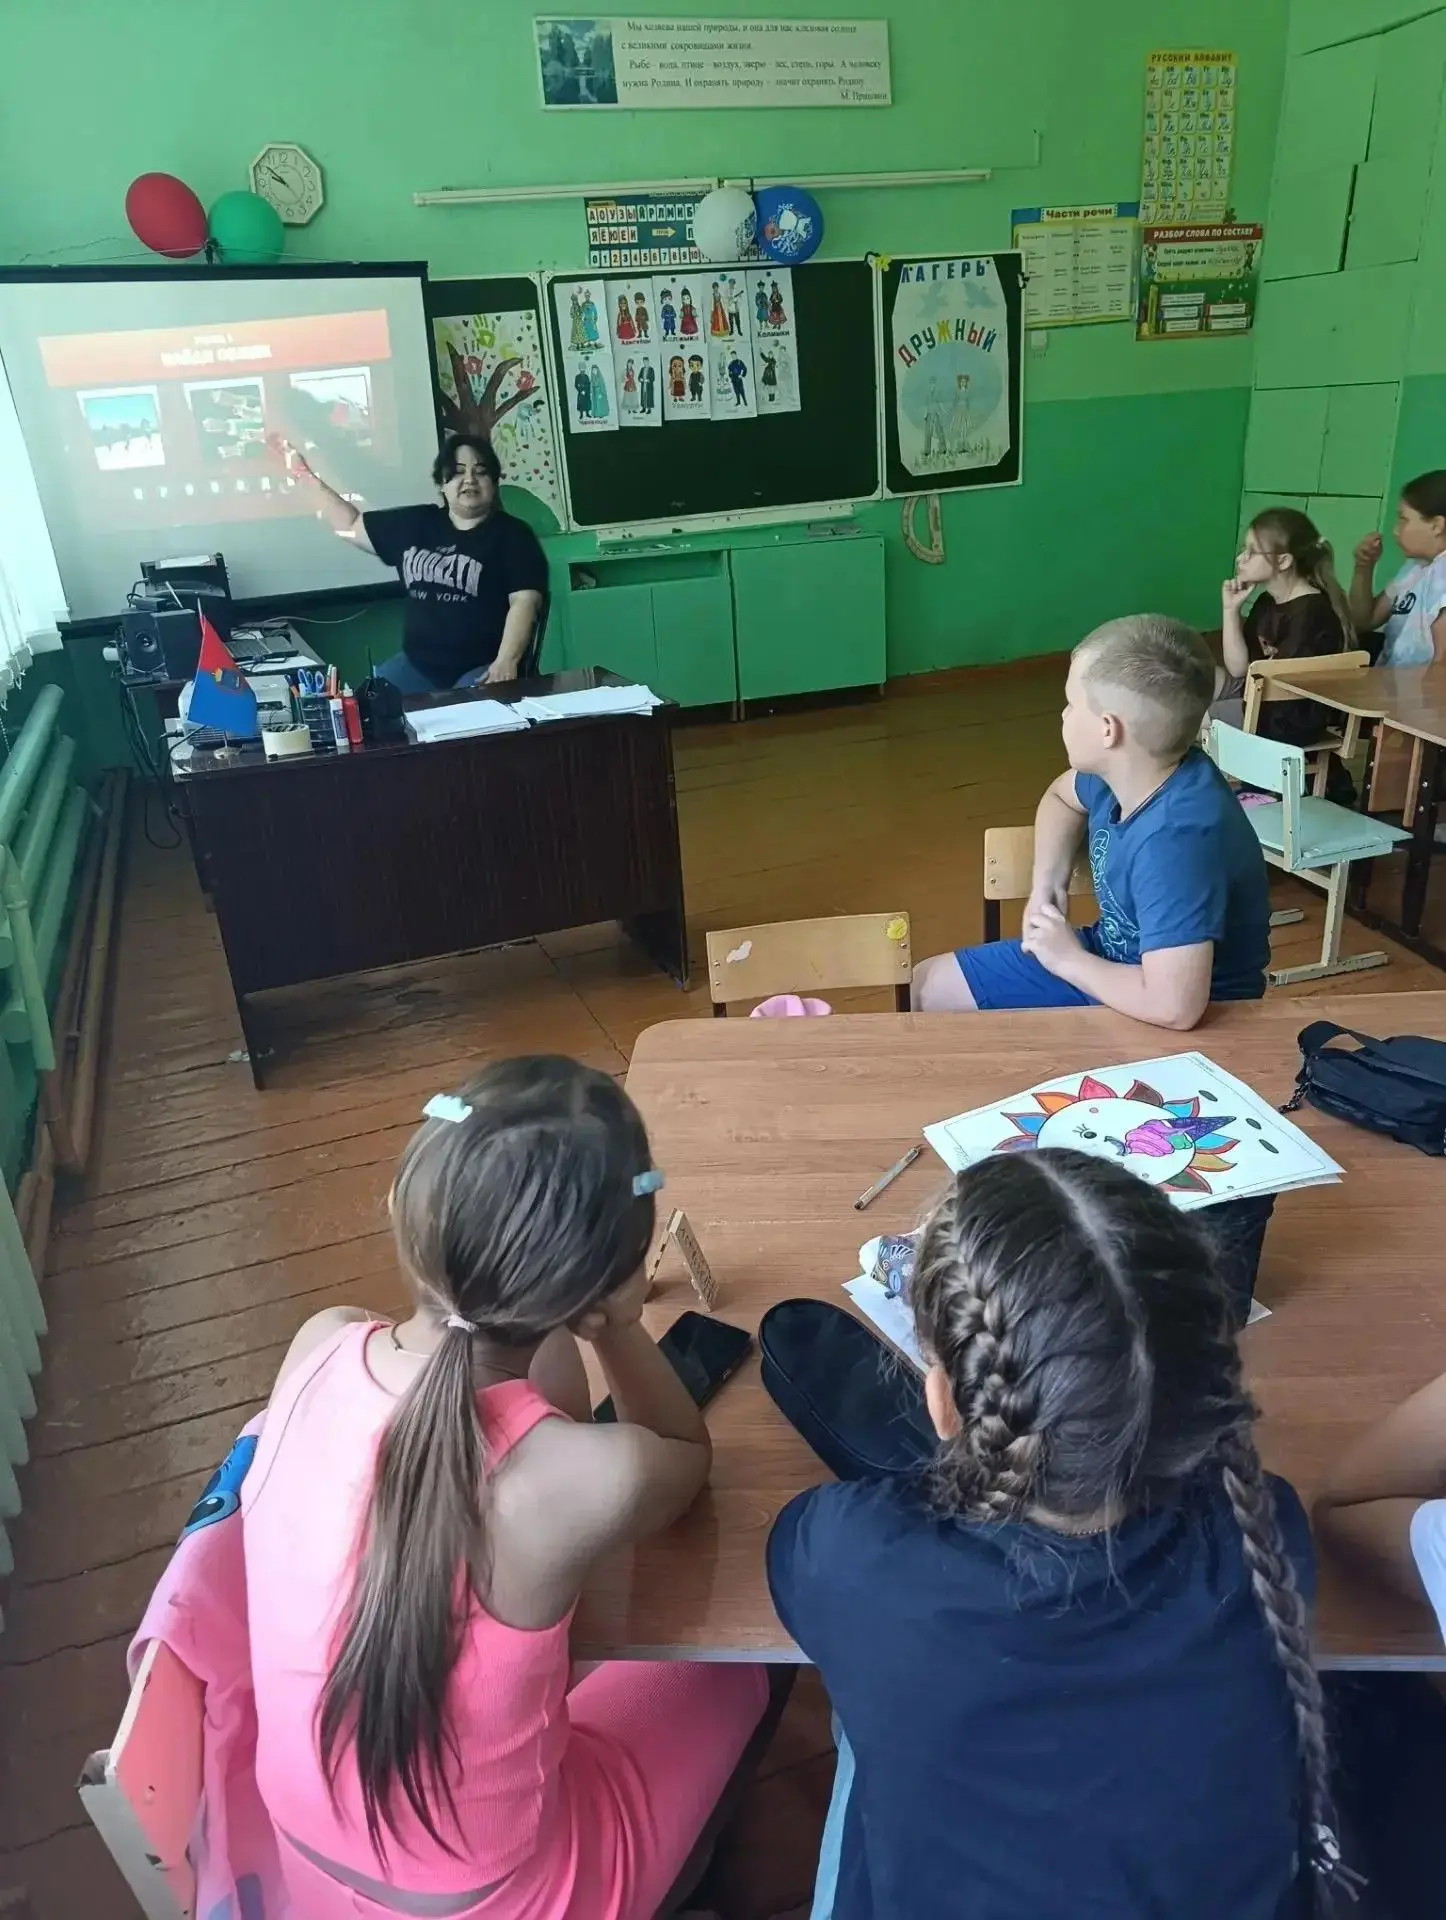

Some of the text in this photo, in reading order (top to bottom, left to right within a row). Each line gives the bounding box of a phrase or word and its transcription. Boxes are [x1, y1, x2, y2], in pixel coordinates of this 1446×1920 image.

[303, 166, 312, 178] 2
[1046, 208, 1113, 219] Части речи
[1154, 228, 1254, 240] РАЗБОР СЛОВА ПО СОСТАВУ
[692, 250, 698, 260] 10
[901, 260, 986, 284] ЛАГЕРЬ
[898, 318, 997, 369] ДРУЖНЫЙ
[436, 592, 469, 602] YORK
